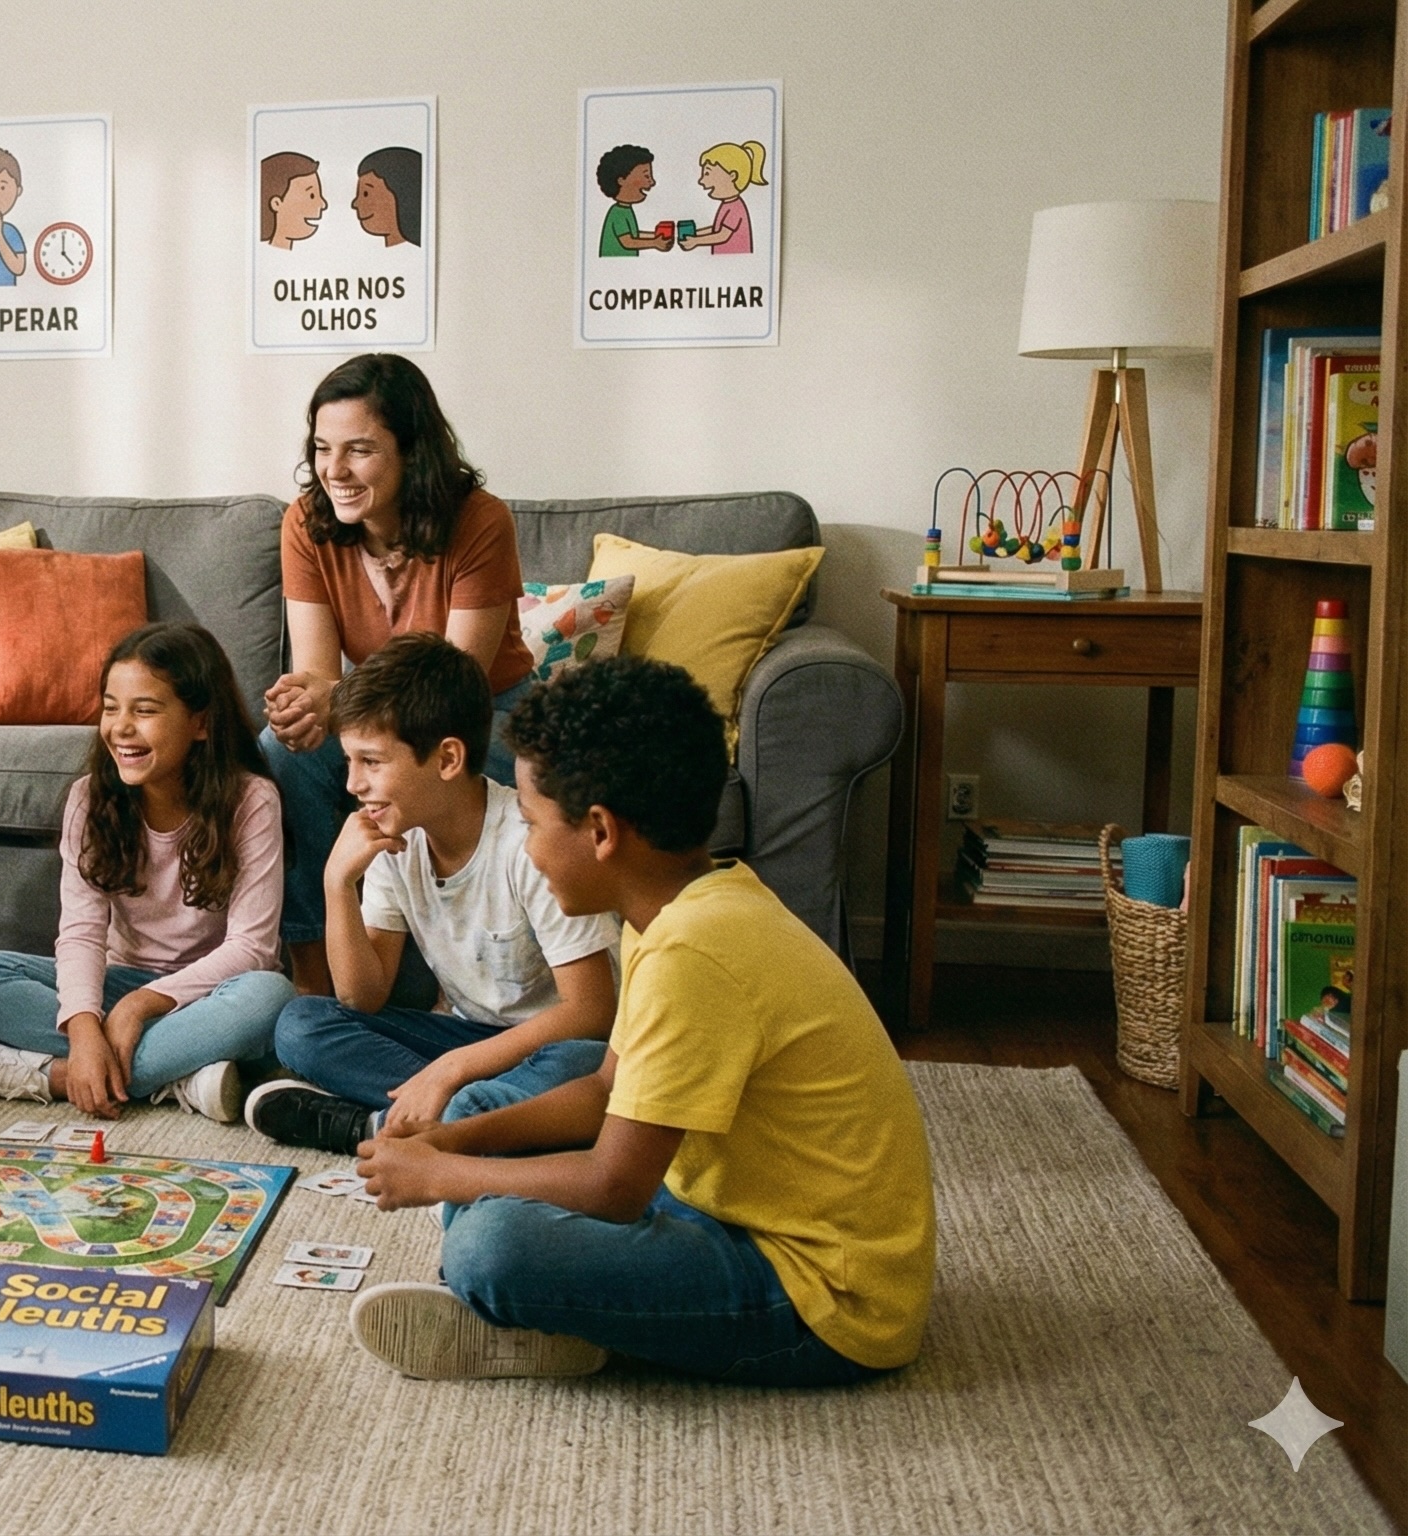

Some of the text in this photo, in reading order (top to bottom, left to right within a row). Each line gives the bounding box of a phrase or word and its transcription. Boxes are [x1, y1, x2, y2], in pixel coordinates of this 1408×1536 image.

[274, 276, 405, 302] OLHAR NOS
[589, 286, 764, 311] COMPARTILHAR
[301, 307, 377, 331] OLHOS
[0, 1273, 168, 1310] Social
